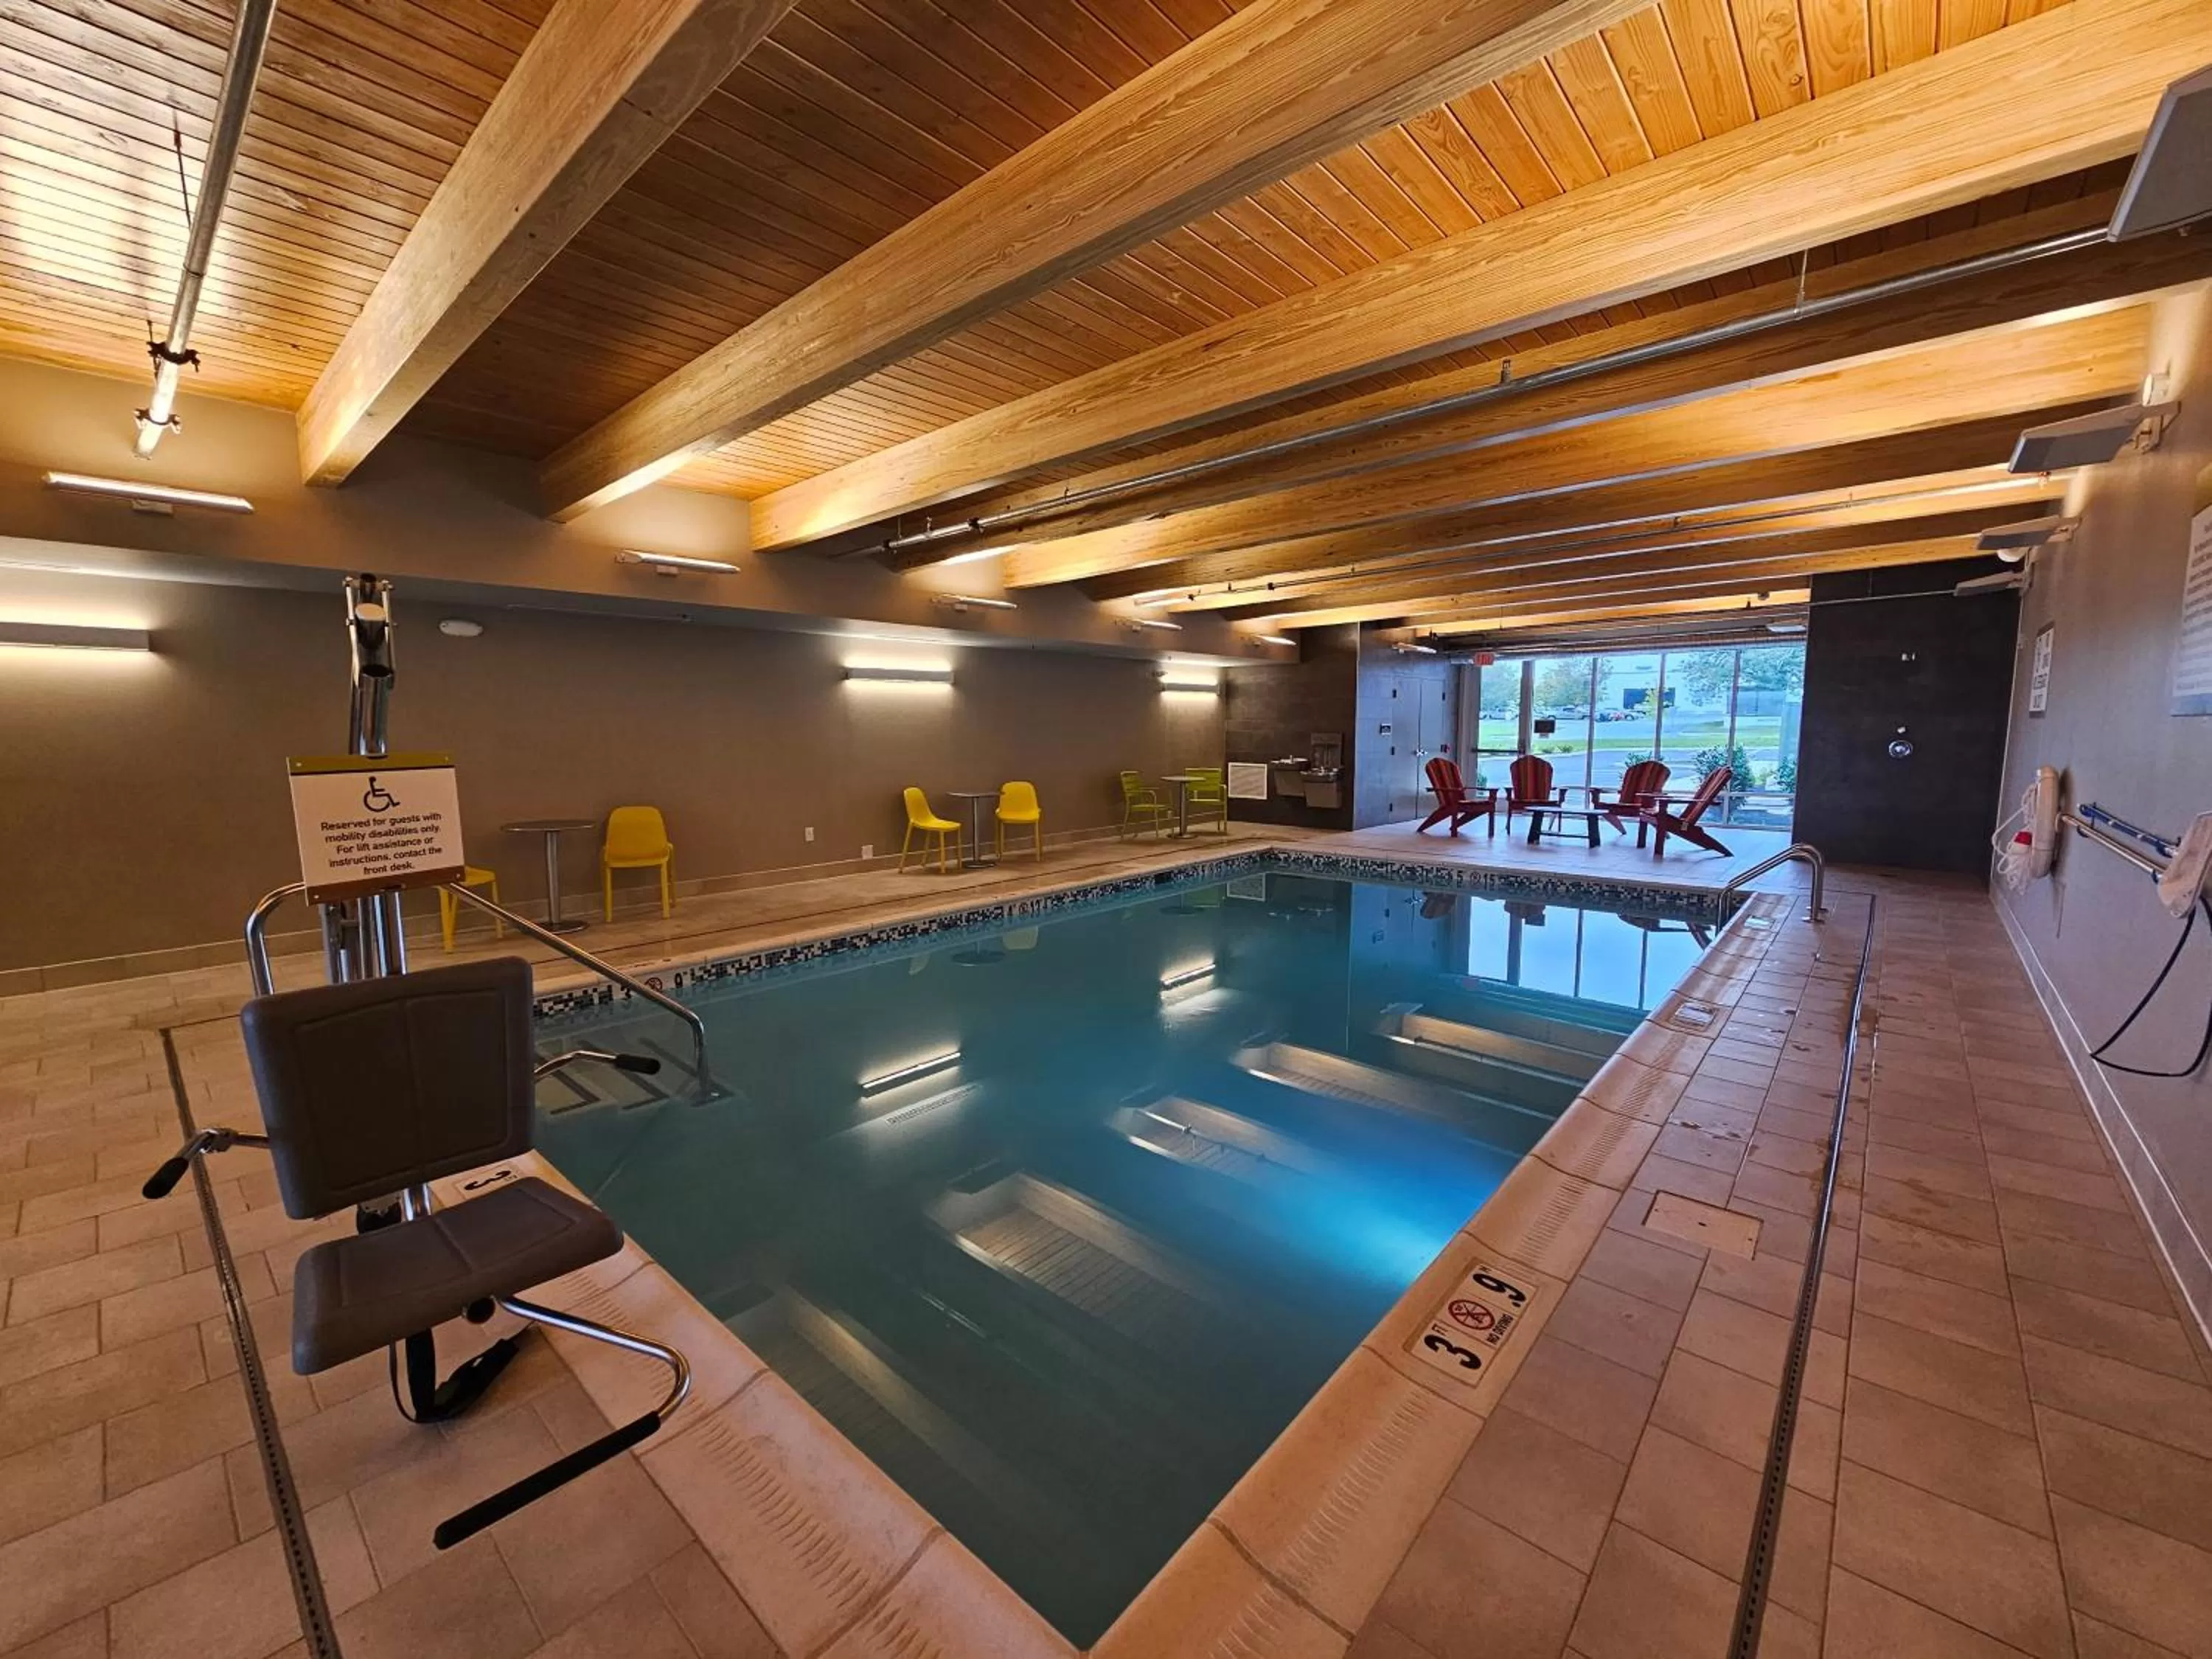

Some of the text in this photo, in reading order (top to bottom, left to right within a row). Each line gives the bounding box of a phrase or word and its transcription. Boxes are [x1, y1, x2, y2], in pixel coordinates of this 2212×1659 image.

[321, 819, 371, 831] Reserved
[372, 817, 386, 826] for
[389, 814, 421, 827] guests
[325, 831, 366, 843] mobility
[369, 827, 419, 838] disabilities
[337, 846, 354, 854] For
[357, 843, 370, 851] lift
[372, 838, 422, 849] assistance
[393, 849, 426, 860] contact
[428, 846, 443, 855] the
[364, 866, 388, 875] front
[1424, 1334, 1482, 1370] 3
